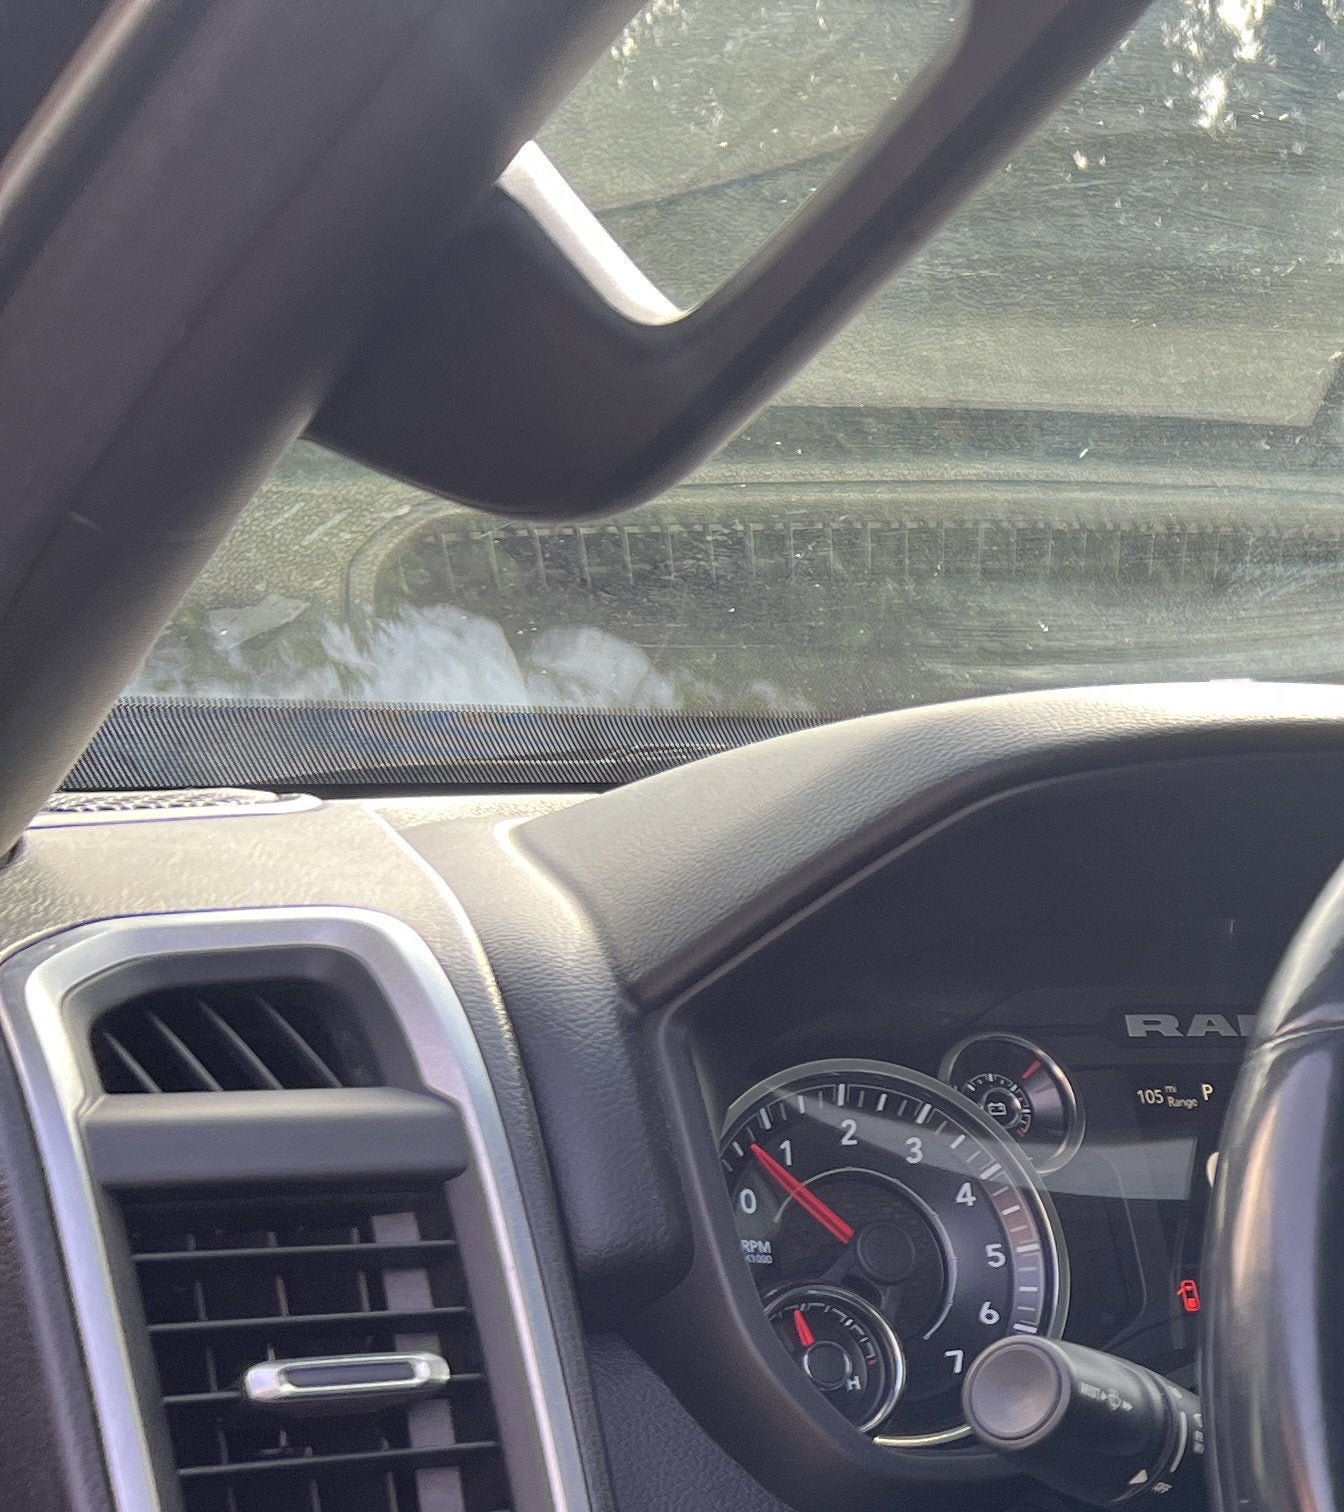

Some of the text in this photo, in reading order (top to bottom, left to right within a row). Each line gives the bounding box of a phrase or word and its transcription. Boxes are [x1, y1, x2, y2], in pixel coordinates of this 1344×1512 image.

[1136, 1089, 1199, 1110] 105 Range
[1201, 1083, 1214, 1101] P
[840, 1119, 858, 1146] 2
[780, 1140, 792, 1165] 1
[905, 1137, 923, 1164] 3
[740, 1189, 757, 1214] 0
[956, 1182, 976, 1206] 4
[740, 1239, 771, 1253] RPM
[986, 1244, 1006, 1268] 5
[979, 1302, 1000, 1325] 6
[944, 1350, 963, 1373] 7
[846, 1375, 862, 1391] H
